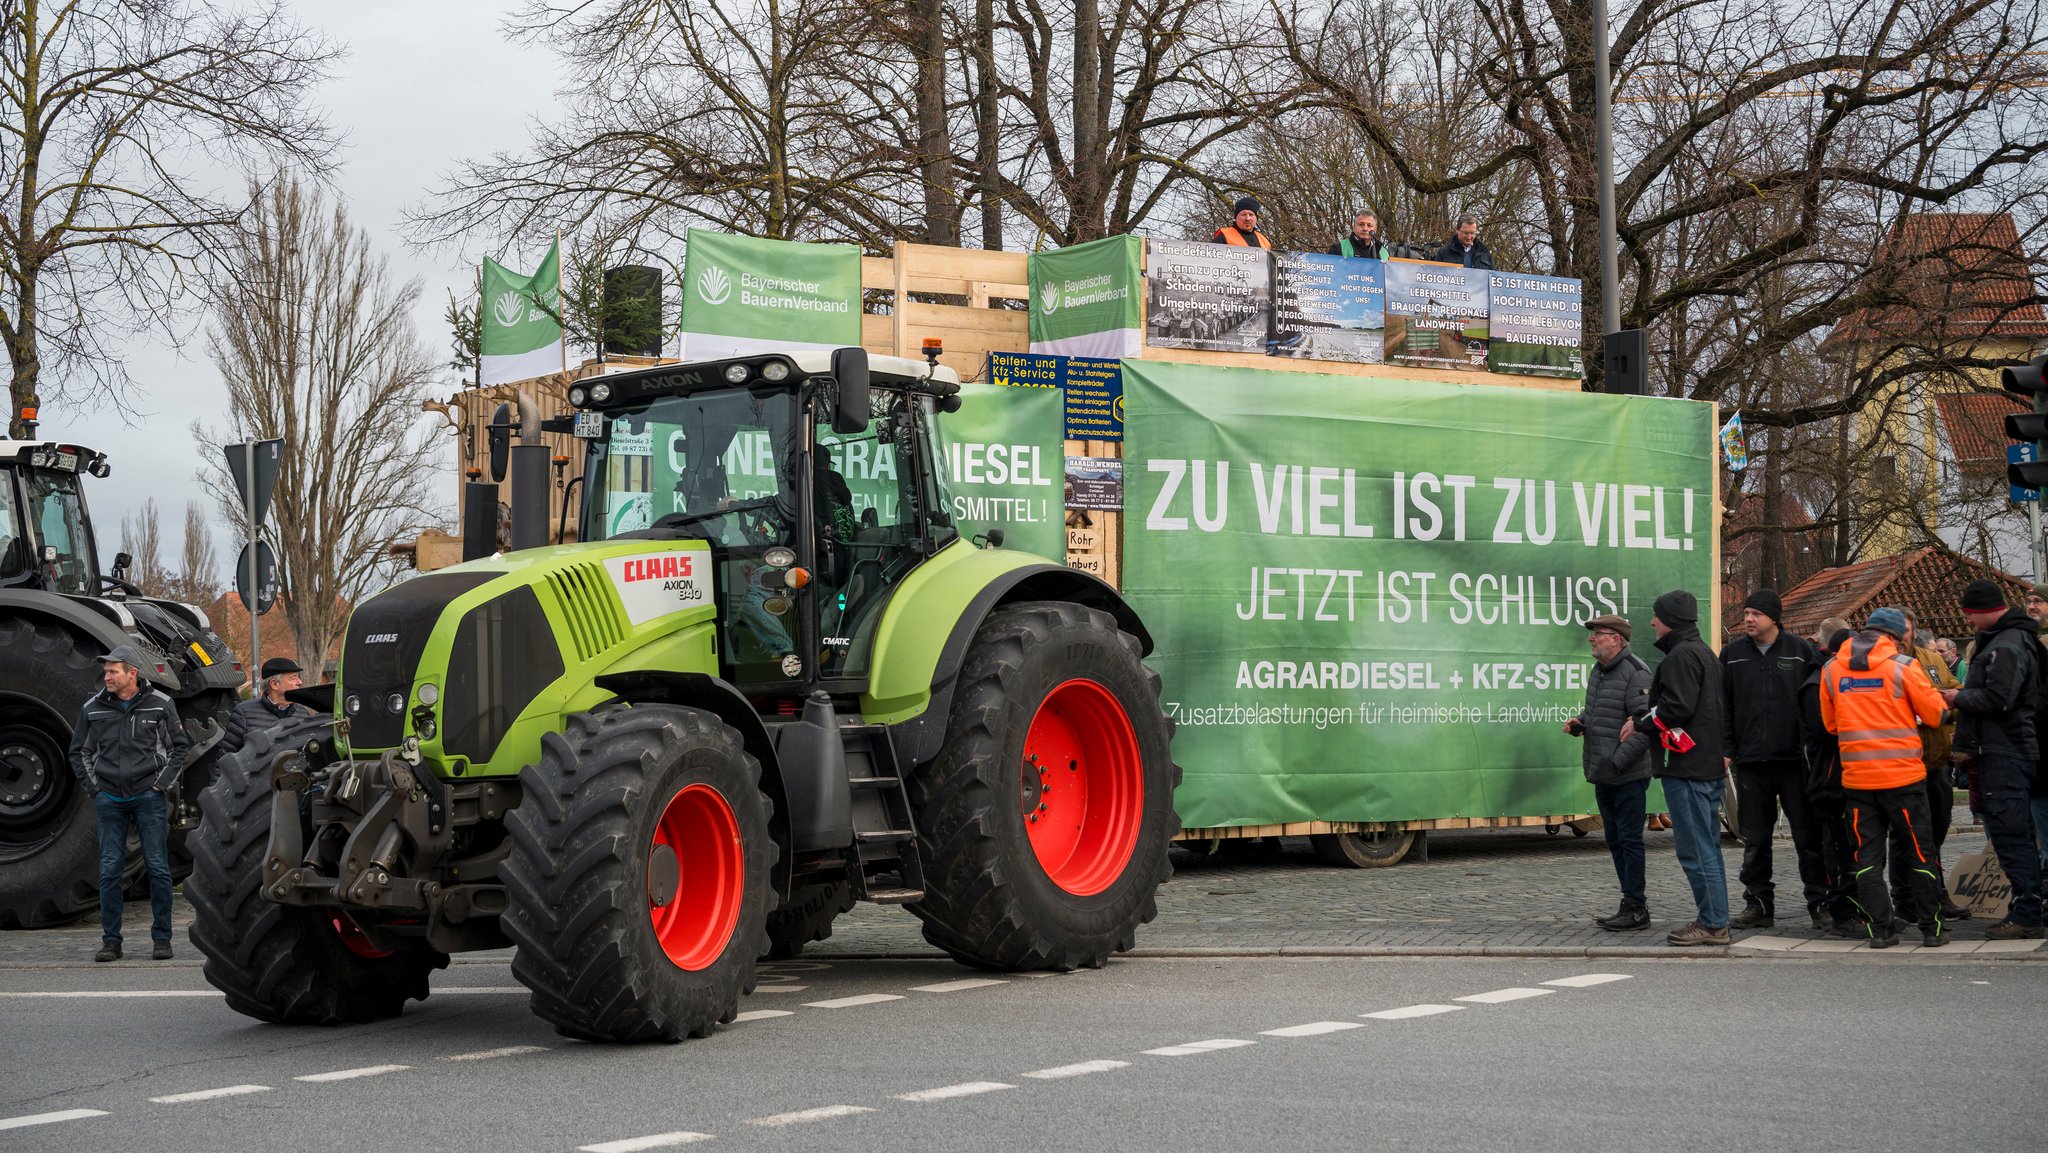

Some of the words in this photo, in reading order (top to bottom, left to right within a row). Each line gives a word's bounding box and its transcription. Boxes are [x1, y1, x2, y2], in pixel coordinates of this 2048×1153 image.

[1158, 243, 1180, 255] Eine
[1183, 244, 1222, 259] defekte
[1226, 248, 1259, 264] Ampel
[1167, 260, 1194, 274] kann
[1213, 266, 1251, 278] großen
[741, 273, 820, 292] Bayerischer
[1065, 274, 1112, 293] Bayerischer
[1166, 279, 1211, 293] Schäden
[1215, 283, 1224, 294] in
[1227, 283, 1253, 295] ihrer
[1416, 273, 1465, 285] REGIONALE
[1491, 277, 1502, 287] ES
[1506, 278, 1521, 289] IST
[1524, 280, 1547, 291] KEIN
[1550, 283, 1575, 294] HERR
[741, 291, 848, 312] BauernVerband
[1065, 285, 1128, 308] BauernVerband
[1410, 288, 1471, 301] LEBENSMITTEL
[1160, 296, 1217, 313] Umgebung
[1221, 301, 1259, 313] führen!
[1391, 302, 1437, 314] BRAUCHEN
[1441, 306, 1488, 317] REGIONALE
[1494, 296, 1522, 307] HOCH
[1525, 299, 1537, 308] IM
[1541, 300, 1569, 312] LAND,
[1415, 319, 1465, 331] LANDWIRTE
[1501, 313, 1533, 326] NICHT
[1536, 317, 1558, 328] LEBT
[1561, 319, 1582, 330] VOM
[1506, 333, 1578, 347] BAUERNSTAND
[993, 355, 1031, 366] Reifen-
[1036, 359, 1056, 369] und
[1067, 360, 1090, 368] Sommer-
[993, 366, 1055, 379] Kfz-Service
[1086, 370, 1115, 378] Stahlfelgen
[641, 372, 703, 390] AXION
[581, 414, 590, 424] ED
[1067, 417, 1087, 425] Optima
[576, 426, 585, 435] HT
[587, 425, 600, 436] 840
[1147, 459, 1229, 532] ZU
[1250, 463, 1373, 537] VIEL
[1394, 471, 1475, 542] IST
[1493, 477, 1557, 546] ZU
[1573, 482, 1694, 550] VIEL!
[1070, 532, 1093, 546] Rohr
[625, 557, 692, 582] CLAAS
[664, 580, 693, 590] AXION
[679, 589, 702, 600] 840
[1236, 567, 1363, 622] JETZT
[1378, 571, 1436, 623] IST
[1450, 572, 1629, 626] SCHLUSS!
[365, 634, 398, 644] CLAAS
[823, 637, 850, 645] CMATIC
[1236, 661, 1440, 690] AGRARDIESEL
[1450, 671, 1463, 689] +
[1166, 702, 1352, 730] Zusatzbelastungen
[1360, 703, 1384, 724] für
[1390, 702, 1481, 724] heimische
[1953, 873, 2012, 905] Waffen
